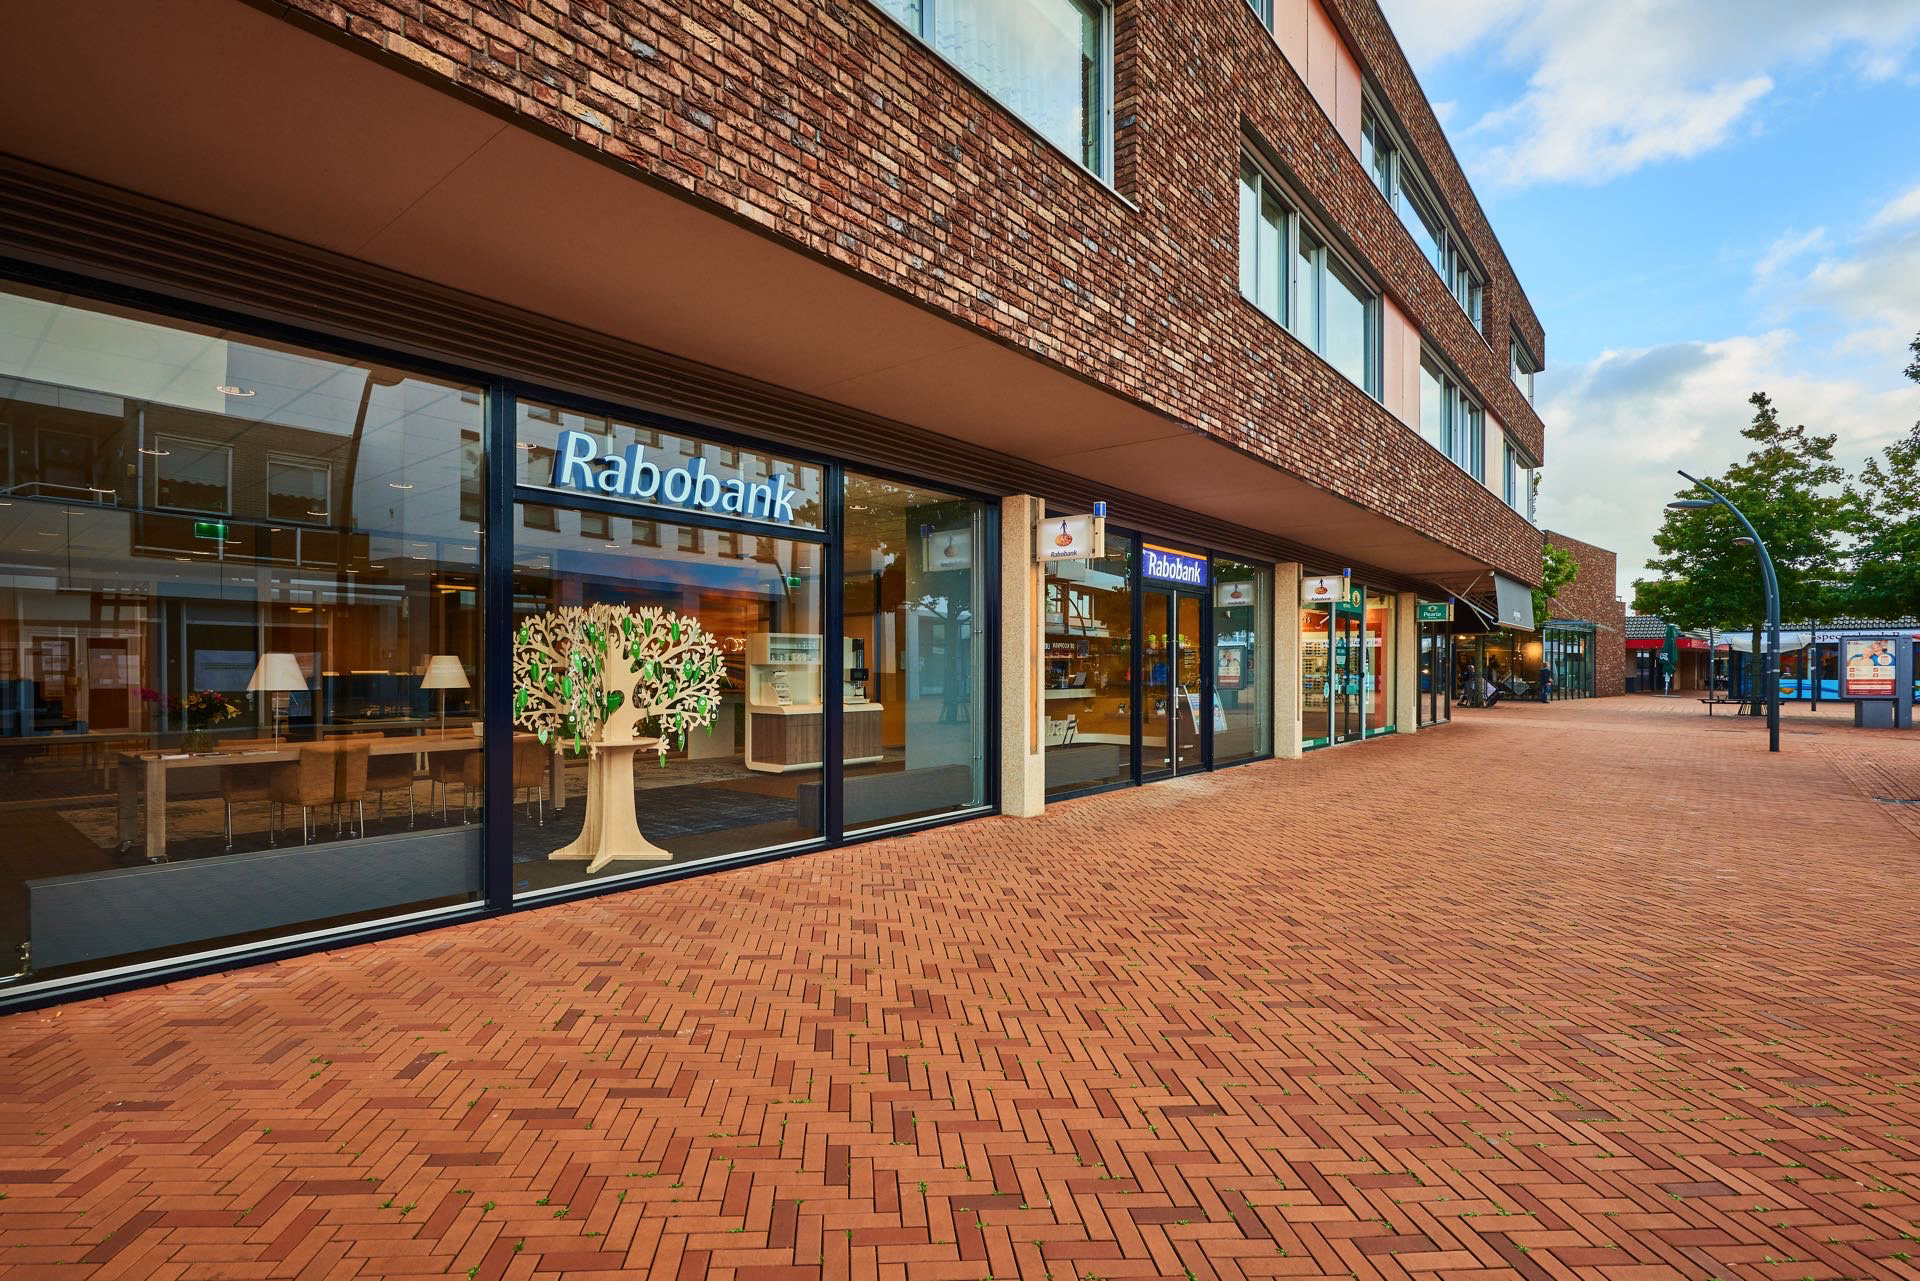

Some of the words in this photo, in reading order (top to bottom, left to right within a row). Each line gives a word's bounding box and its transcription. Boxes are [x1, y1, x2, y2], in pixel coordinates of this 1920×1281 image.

[559, 430, 796, 521] Rabobank
[1050, 550, 1077, 558] Rabobank
[1148, 551, 1201, 583] Rabobank
